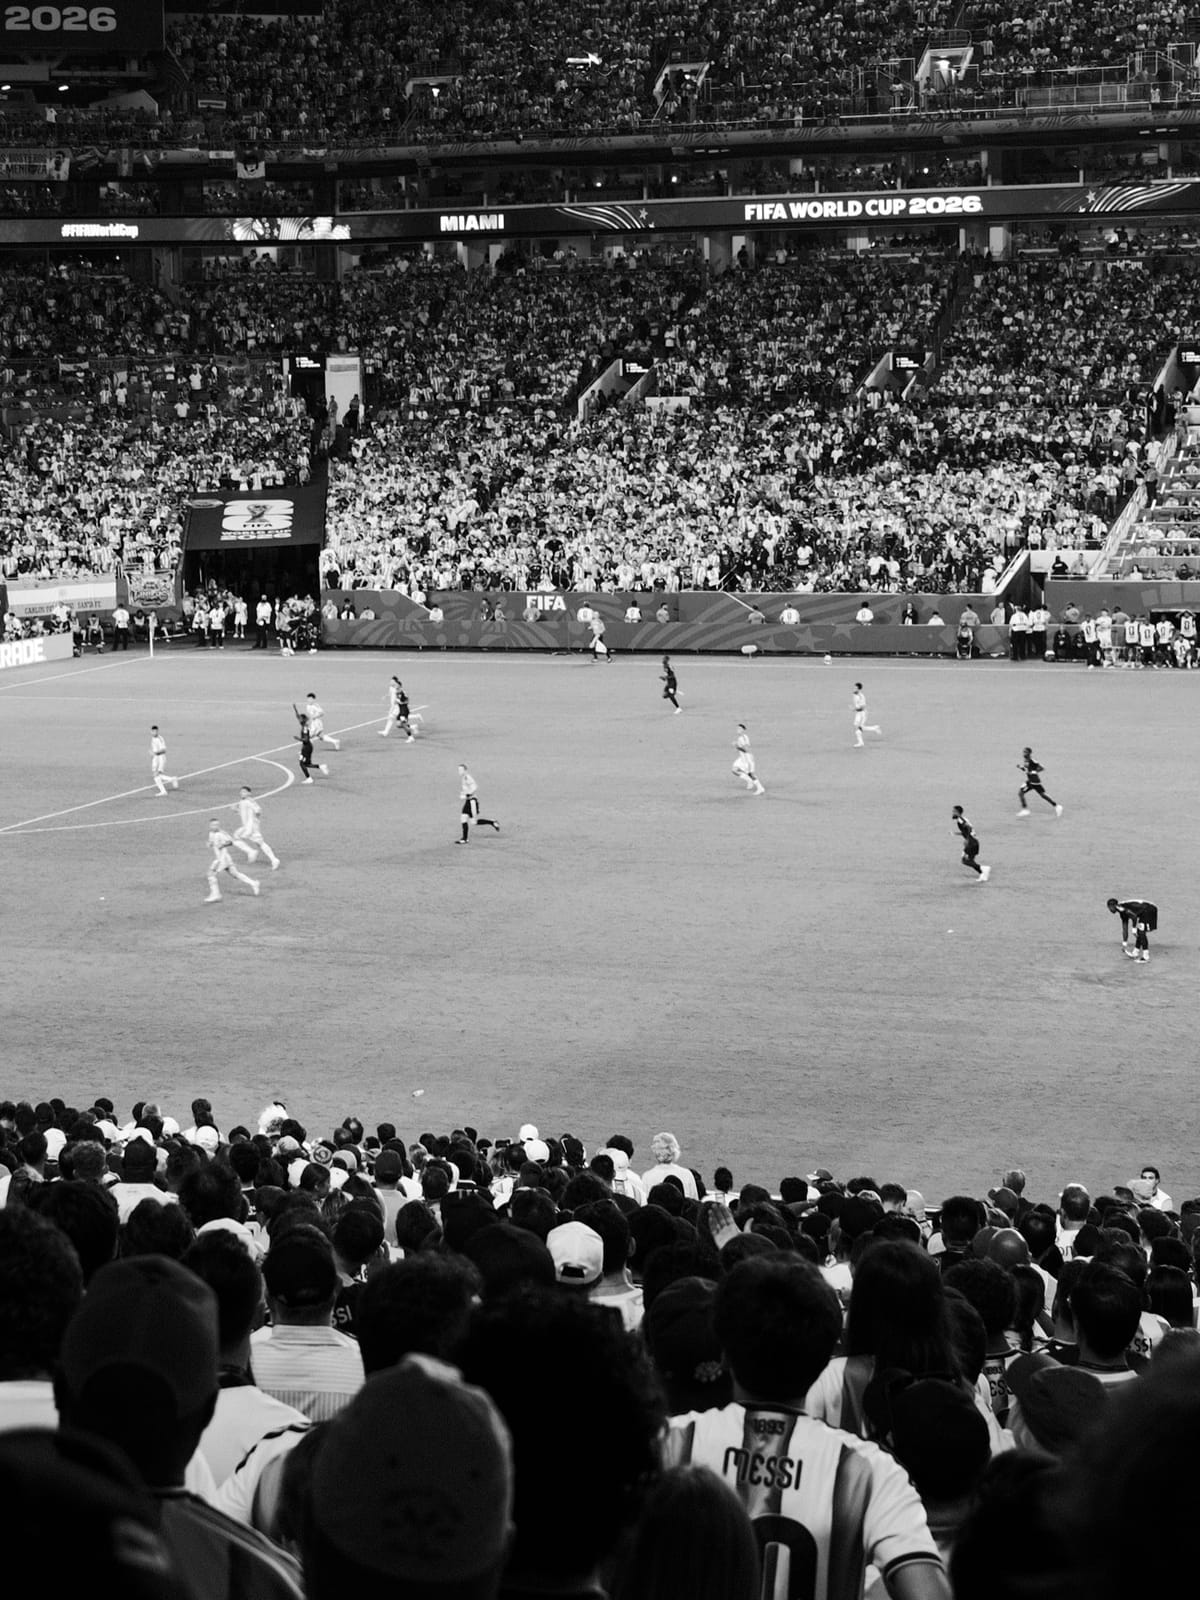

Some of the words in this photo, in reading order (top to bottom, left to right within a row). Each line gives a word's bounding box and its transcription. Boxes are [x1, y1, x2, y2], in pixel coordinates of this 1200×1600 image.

[4, 5, 118, 32] 2026
[744, 202, 788, 221] FIFA
[789, 199, 863, 220] WORLD
[864, 198, 907, 218] CUP
[908, 195, 984, 216] 2026
[60, 222, 139, 239] #FIFAWorldCup
[439, 213, 505, 232] MIAMI
[526, 594, 567, 611] FIFA
[752, 1418, 786, 1435] 1893
[723, 1446, 803, 1490] MESSI
